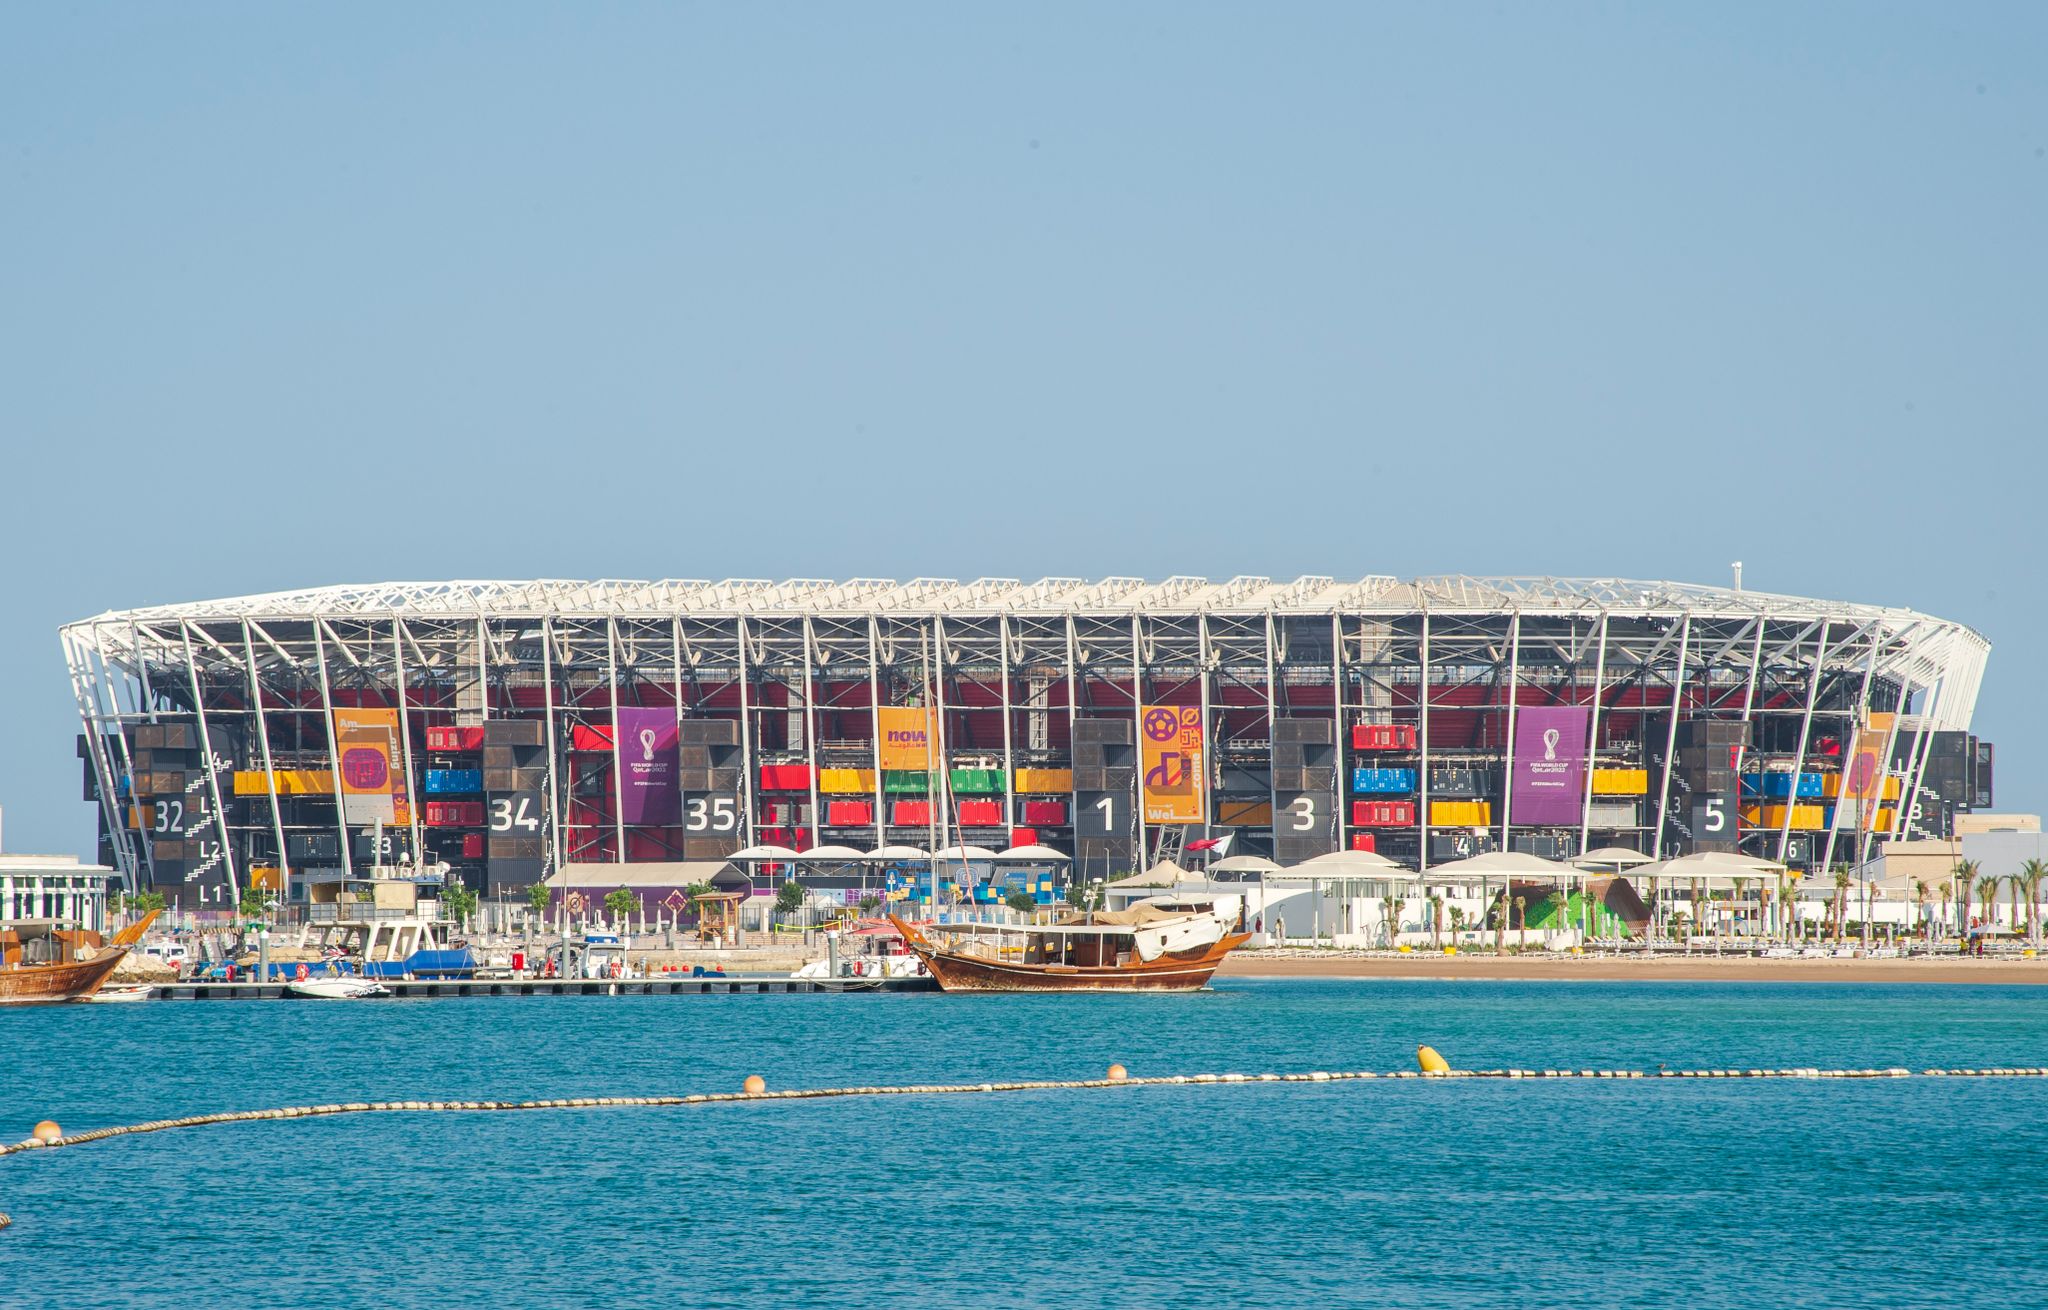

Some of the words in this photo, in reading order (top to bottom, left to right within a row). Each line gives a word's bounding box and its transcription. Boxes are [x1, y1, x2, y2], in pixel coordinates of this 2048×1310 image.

[1192, 752, 1201, 788] come
[155, 800, 183, 833] 32
[491, 798, 538, 831] 34
[686, 798, 735, 831] 35
[1096, 797, 1112, 831] 1
[1293, 797, 1315, 831] 3
[1705, 799, 1725, 832] 5
[200, 841, 220, 858] L2
[1456, 837, 1470, 855] 4
[1788, 841, 1797, 859] 6
[200, 885, 221, 902] L1
